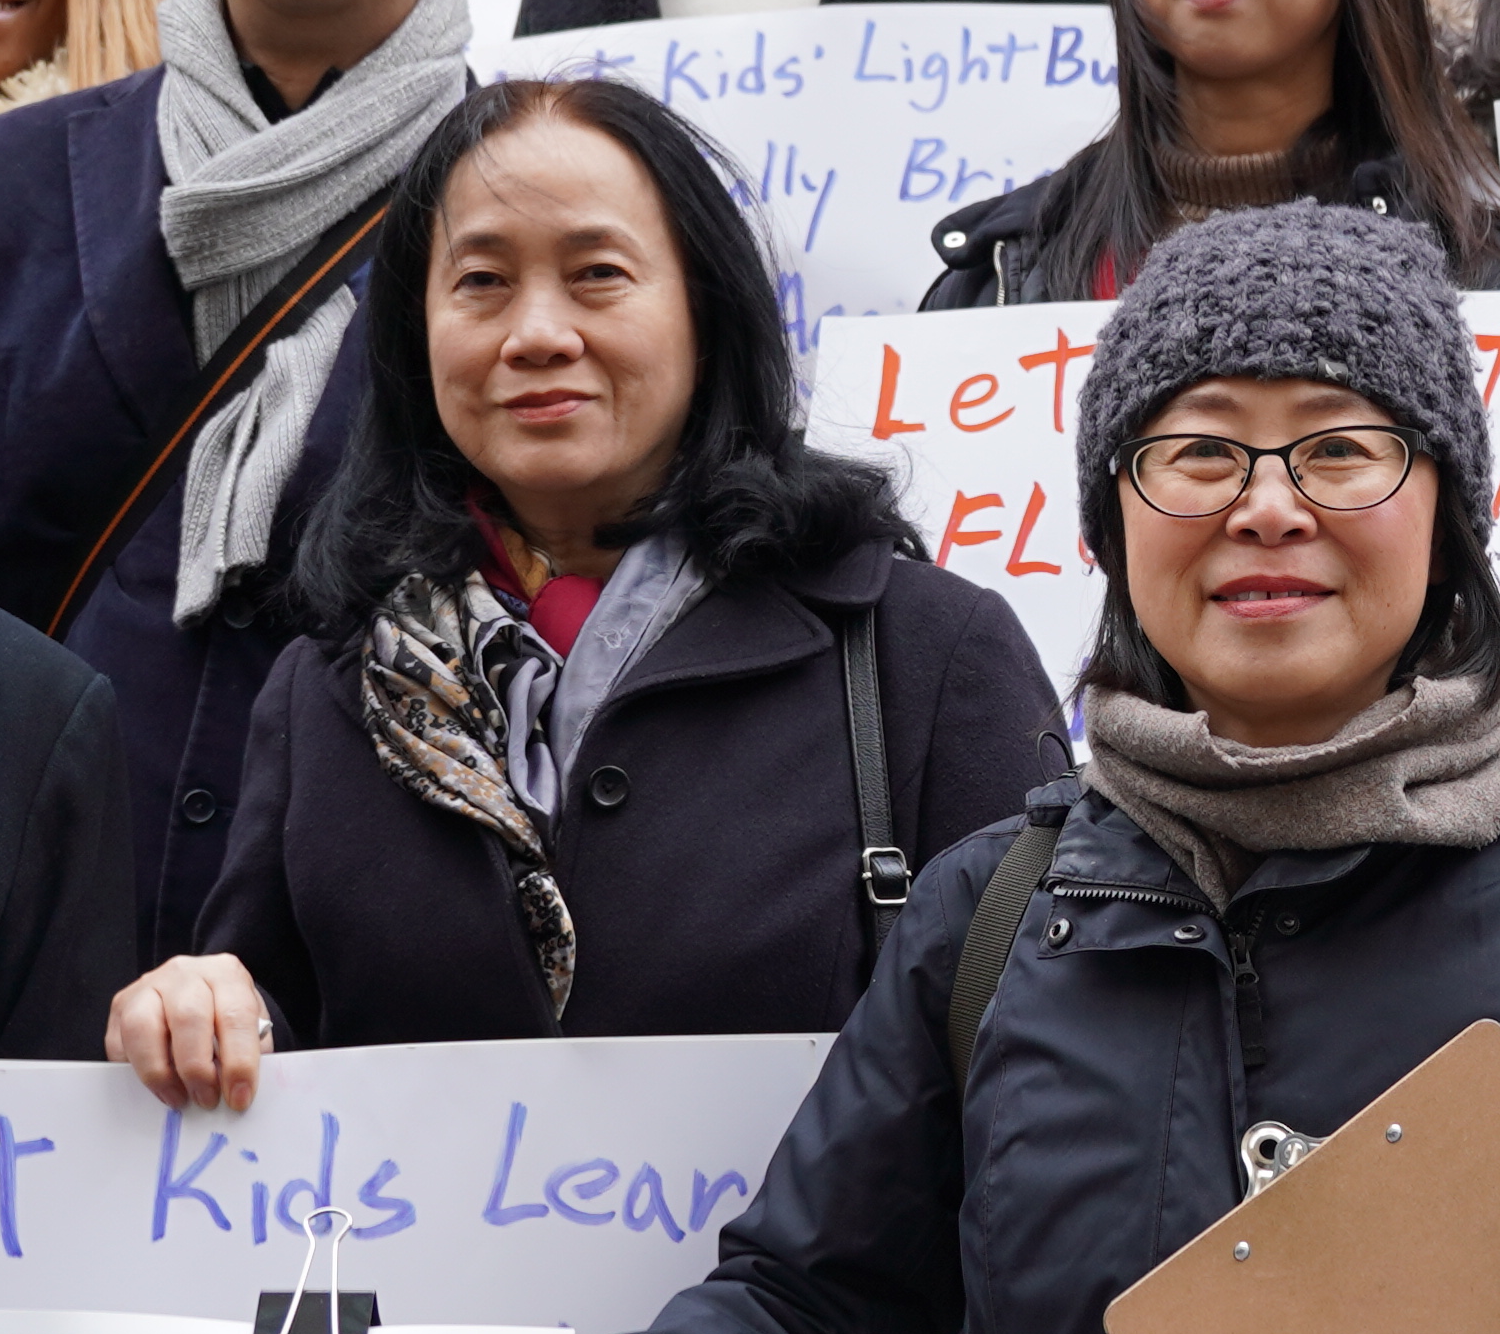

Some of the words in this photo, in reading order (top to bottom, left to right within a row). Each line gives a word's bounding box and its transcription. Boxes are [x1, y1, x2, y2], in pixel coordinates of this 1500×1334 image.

[853, 19, 1040, 113] Light
[870, 326, 1096, 441] Let
[151, 1104, 417, 1246] Kids
[482, 1101, 749, 1243] Lear
